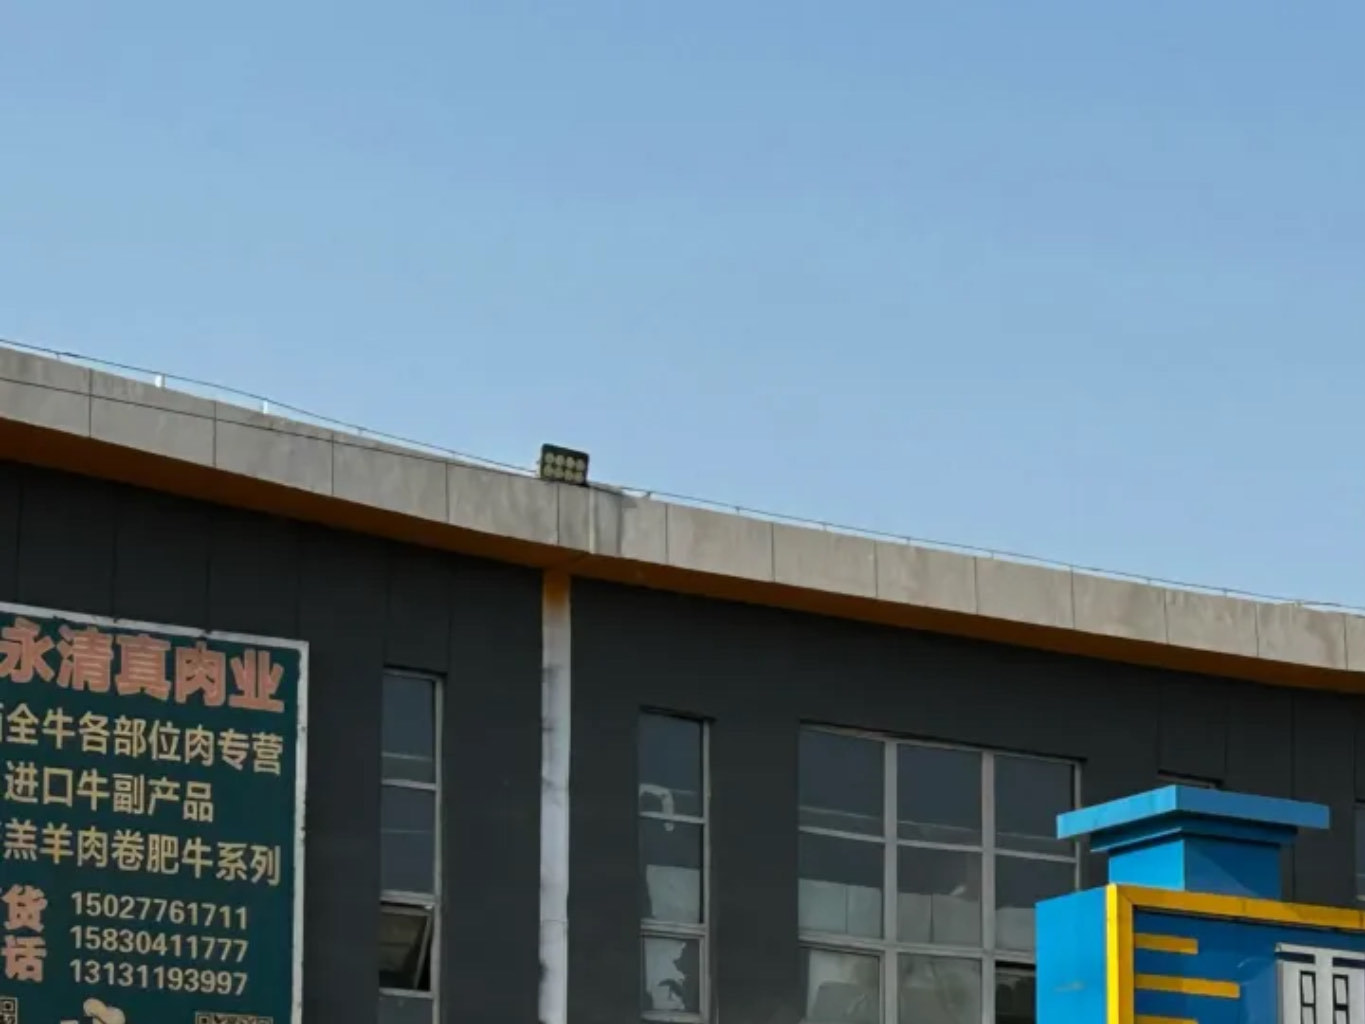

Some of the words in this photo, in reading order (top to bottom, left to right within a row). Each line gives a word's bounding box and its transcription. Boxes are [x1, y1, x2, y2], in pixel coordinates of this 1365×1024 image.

[0, 617, 285, 713] 永清真肉业
[0, 702, 284, 775] 全牛各部位肉专营
[5, 761, 214, 823] 进口牛副产品
[4, 817, 281, 886] 羔羊肉卷肥牛系列
[71, 891, 248, 930] 15027761711
[70, 925, 248, 963] 15830411777
[70, 959, 248, 996] 13131193997
